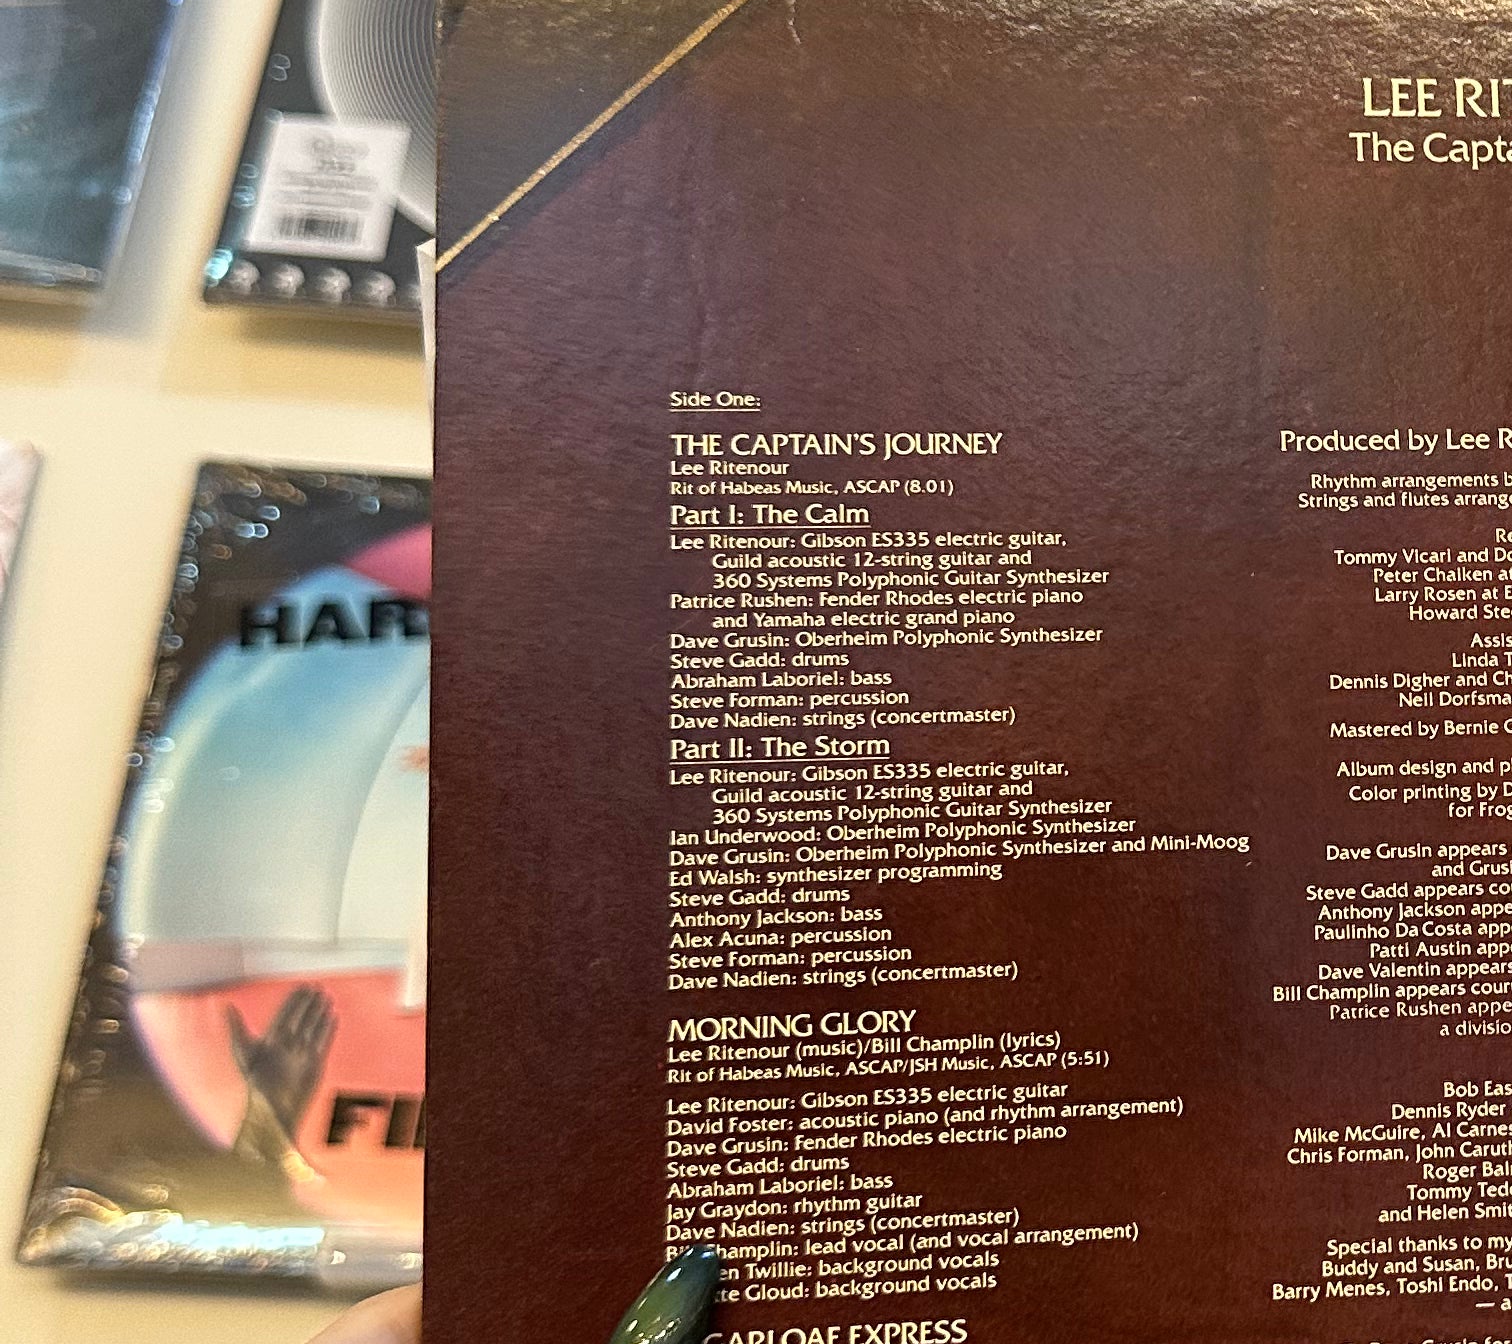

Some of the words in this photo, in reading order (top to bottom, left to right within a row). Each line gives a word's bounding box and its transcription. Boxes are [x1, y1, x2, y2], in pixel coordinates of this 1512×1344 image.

[1362, 77, 1442, 118] LEE
[1348, 131, 1415, 162] The
[669, 391, 712, 407] Side
[715, 391, 761, 407] One:
[670, 433, 724, 456] THE
[730, 432, 876, 456] CAPTAIN'S
[883, 432, 1003, 461] JOURNEY
[1280, 428, 1401, 452] Produced
[1408, 428, 1439, 456] by
[1446, 428, 1491, 450] Lee
[670, 460, 705, 476] Lee
[709, 459, 790, 475] Ritenour
[1310, 473, 1377, 493] Rhythm
[1381, 473, 1499, 492] arrangements
[670, 504, 721, 525] Part
[728, 504, 744, 525] I:
[752, 503, 799, 524] The
[804, 503, 870, 524] Calm
[670, 653, 725, 670] Steve
[728, 651, 786, 668] Gadd:
[791, 651, 850, 667] drums
[670, 672, 757, 689] Abraham
[761, 670, 845, 687] Laboriel:
[850, 669, 892, 686] bass
[670, 713, 719, 730] Dave
[722, 711, 797, 728] Nadien:
[802, 710, 866, 730] strings
[870, 706, 1016, 729] (concertmaster)
[1329, 720, 1413, 738] Mastered
[1417, 720, 1440, 740] by
[1444, 719, 1499, 736] Bernie
[670, 739, 721, 760] Part
[729, 737, 753, 759] II:
[760, 736, 808, 758] The
[814, 735, 890, 756] Storm
[666, 1013, 813, 1043] MORNING
[820, 1009, 917, 1036] GLORY
[1443, 1080, 1479, 1098] Bob
